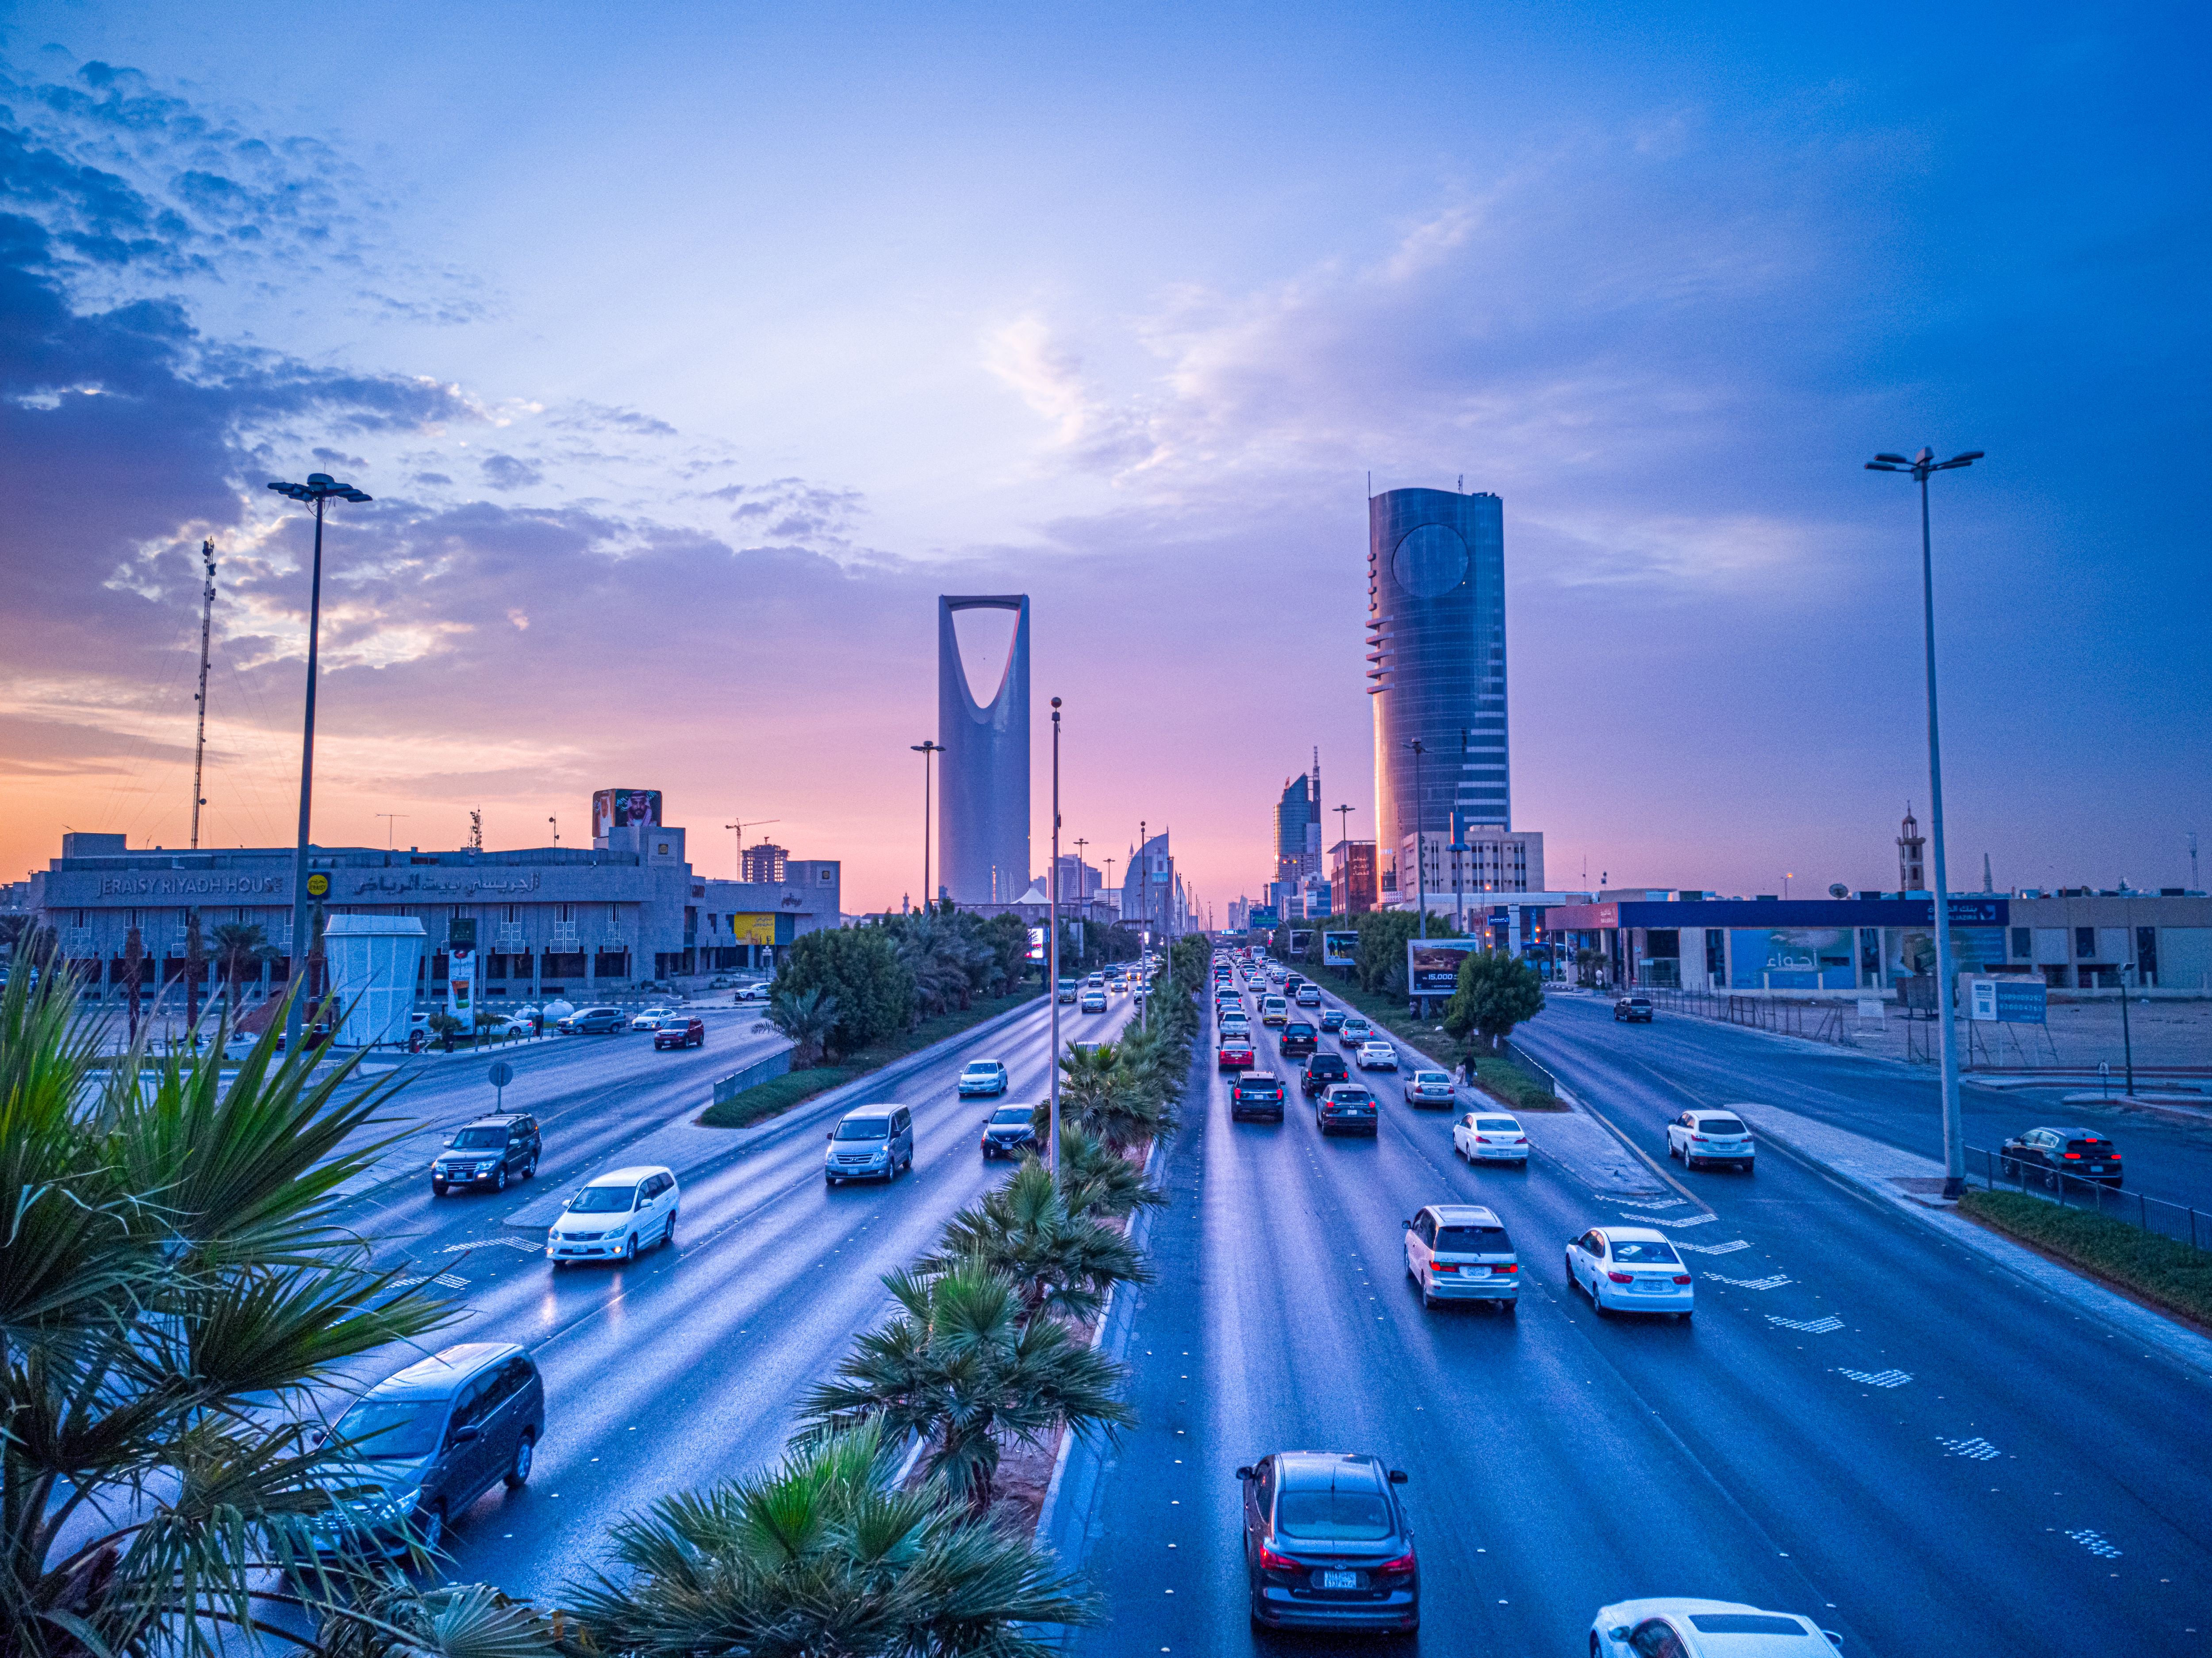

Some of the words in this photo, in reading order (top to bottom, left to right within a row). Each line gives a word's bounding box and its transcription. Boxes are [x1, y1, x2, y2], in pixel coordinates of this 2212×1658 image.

[97, 878, 157, 898] JERAISY
[162, 877, 221, 893] RIYADH
[226, 877, 283, 892] HOUSE
[354, 873, 420, 895] الرياض
[422, 877, 461, 894] بيت
[466, 872, 540, 896] الجريسي
